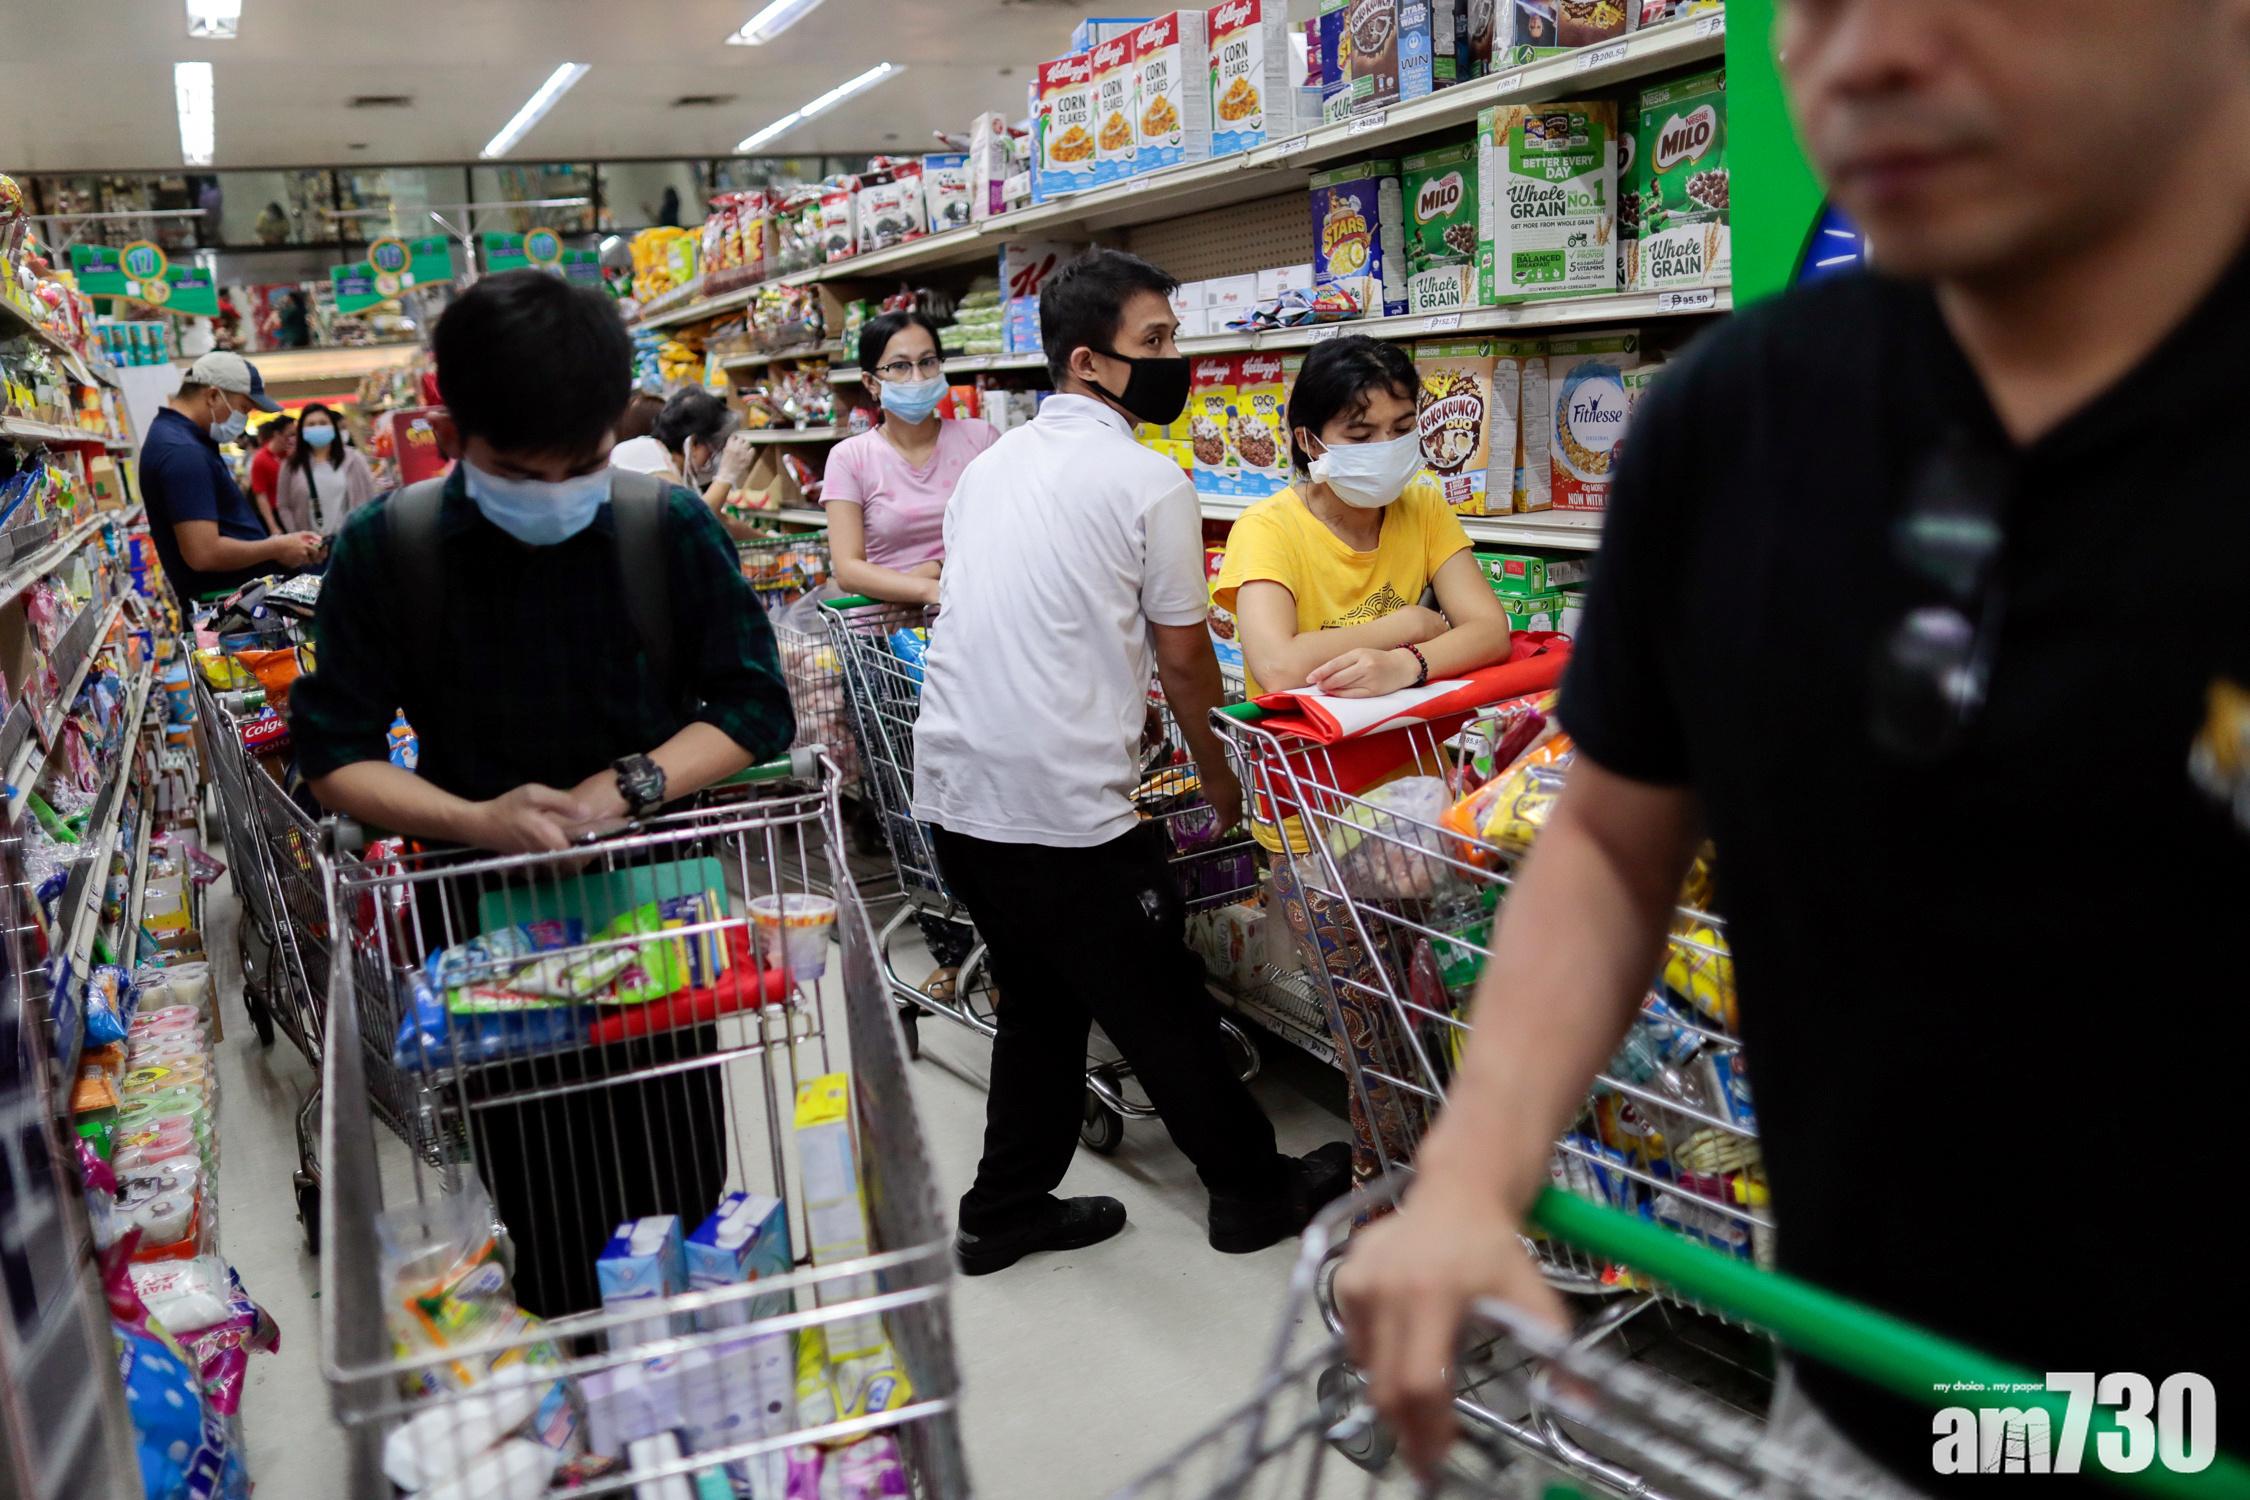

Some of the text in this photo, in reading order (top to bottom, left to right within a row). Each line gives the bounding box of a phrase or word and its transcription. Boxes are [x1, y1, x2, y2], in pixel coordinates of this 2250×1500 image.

[1403, 3, 1427, 15] STAR
[1400, 13, 1426, 28] WARS
[1224, 40, 1249, 64] CORN
[1145, 60, 1168, 82] CORN
[1225, 60, 1250, 79] FLAKES
[1401, 54, 1429, 70] WIN
[1102, 79, 1123, 99] CORN
[1146, 79, 1169, 97] FLAKES
[1058, 94, 1086, 113] CORN
[1103, 95, 1124, 113] FLAKES
[1058, 111, 1088, 126] FLAKES
[1660, 121, 1710, 160] MILO
[1522, 157, 1560, 169] BETTER
[1562, 155, 1595, 167] EVERY
[1545, 167, 1572, 180] DAY
[1421, 184, 1459, 214] MILO
[1506, 184, 1567, 203] Whole
[1510, 200, 1566, 219] GRAIN
[1510, 222, 1521, 230] GET
[1556, 220, 1577, 228] WHOLE
[1323, 216, 1366, 256] STARS
[1648, 237, 1702, 261] Whole
[128, 246, 154, 275] 17
[1516, 254, 1562, 264] BALANCED
[1640, 244, 1648, 288] MORE
[1651, 255, 1702, 279] GRAIN
[1416, 276, 1458, 294] Whole
[1420, 290, 1460, 308] GRAIN
[1671, 294, 1708, 309] ₱95.50
[1204, 396, 1226, 408] COCO
[1252, 394, 1276, 408] COCO
[1573, 403, 1623, 424] Fitnesse
[1445, 418, 1473, 431] DUO
[1567, 492, 1584, 505] NOW
[1585, 493, 1604, 507] WITH
